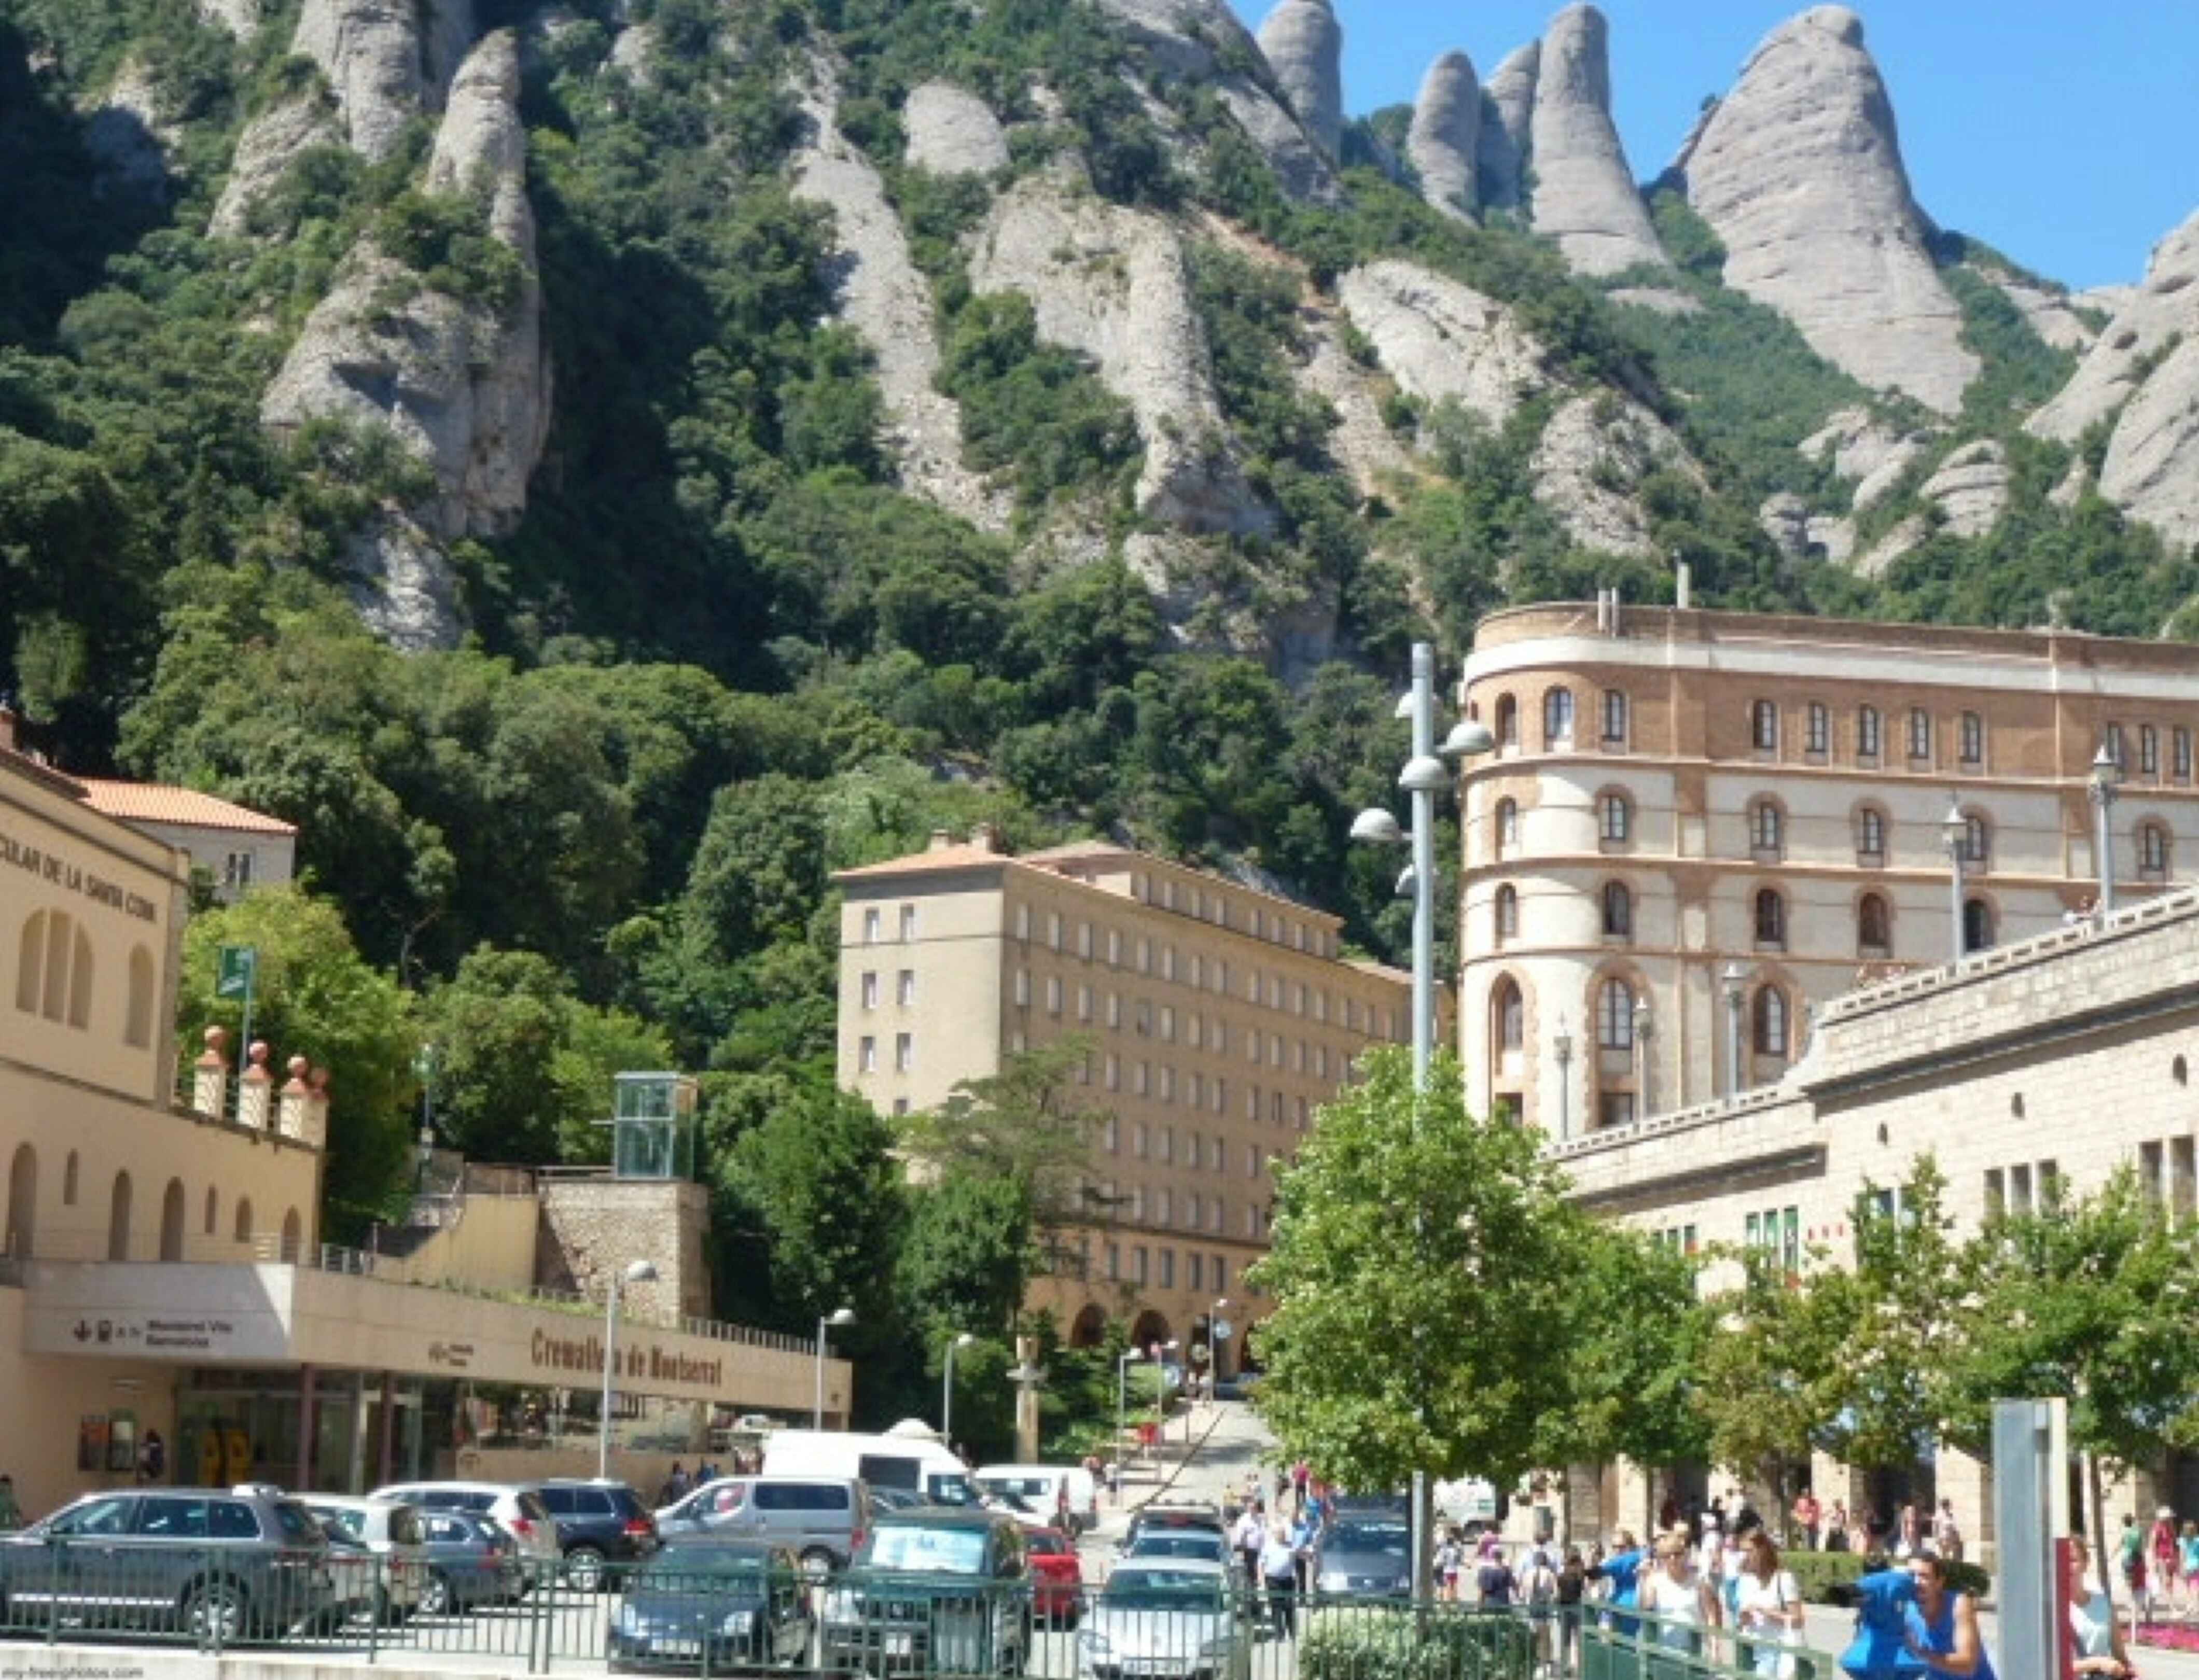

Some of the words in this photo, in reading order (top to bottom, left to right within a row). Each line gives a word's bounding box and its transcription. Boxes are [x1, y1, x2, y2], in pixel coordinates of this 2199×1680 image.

[43, 853, 63, 885] DE
[67, 864, 81, 892] LA
[532, 1327, 622, 1377] Cremallea
[628, 1342, 645, 1377] de
